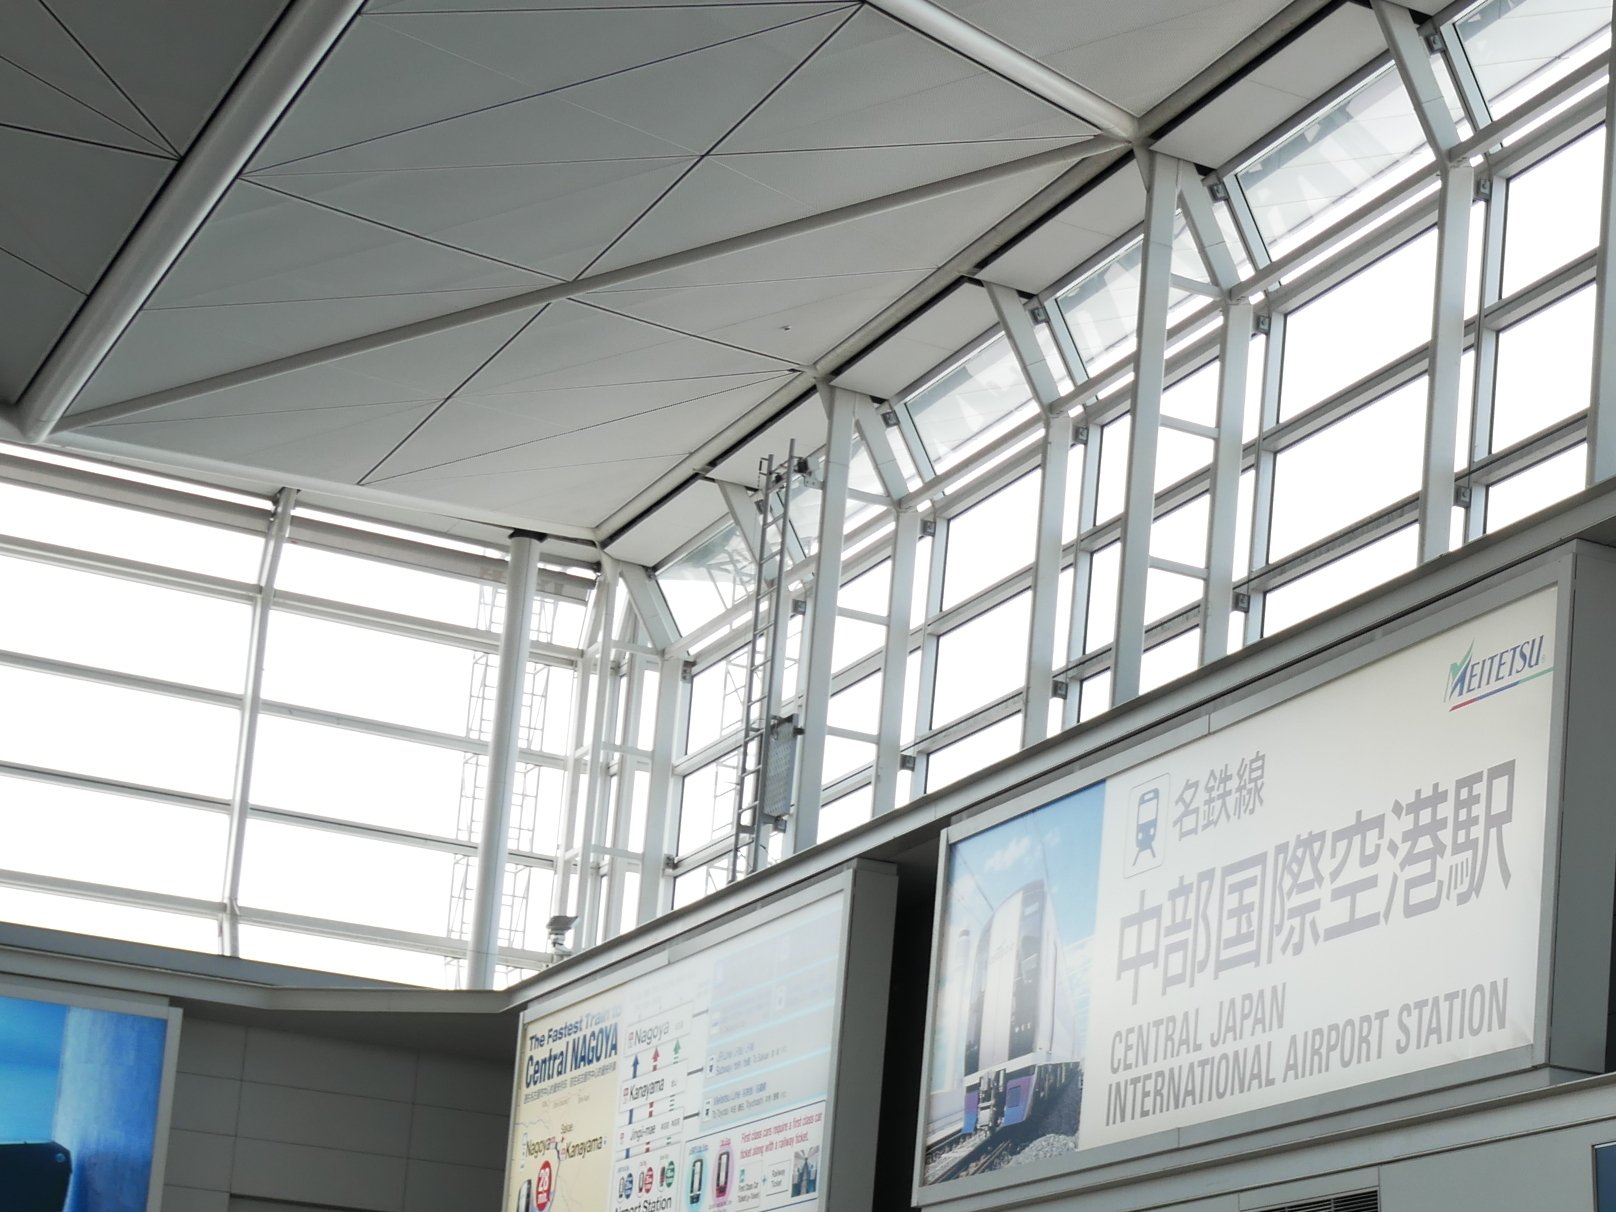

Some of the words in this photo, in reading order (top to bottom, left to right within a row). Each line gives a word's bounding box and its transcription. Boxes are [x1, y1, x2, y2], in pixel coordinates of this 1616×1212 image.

[1443, 635, 1545, 703] MEITETSU
[1172, 750, 1267, 842] 名鉄線
[1116, 758, 1517, 1006] 中部国際空港駅
[525, 1041, 569, 1089] Central
[569, 1022, 618, 1072] NAGOYA
[529, 1033, 545, 1051] The
[547, 1019, 583, 1044] Fastest
[634, 1021, 670, 1046] Nagoya
[1105, 1041, 1276, 1127] INTERNATIONAL
[1282, 1008, 1389, 1084] AIRPORT
[1396, 977, 1509, 1055] STATION
[1110, 1007, 1203, 1075] CENTRAL
[1209, 982, 1287, 1048] JAPAN
[629, 1078, 665, 1101] Kanayama
[564, 1136, 603, 1159] Kanayama
